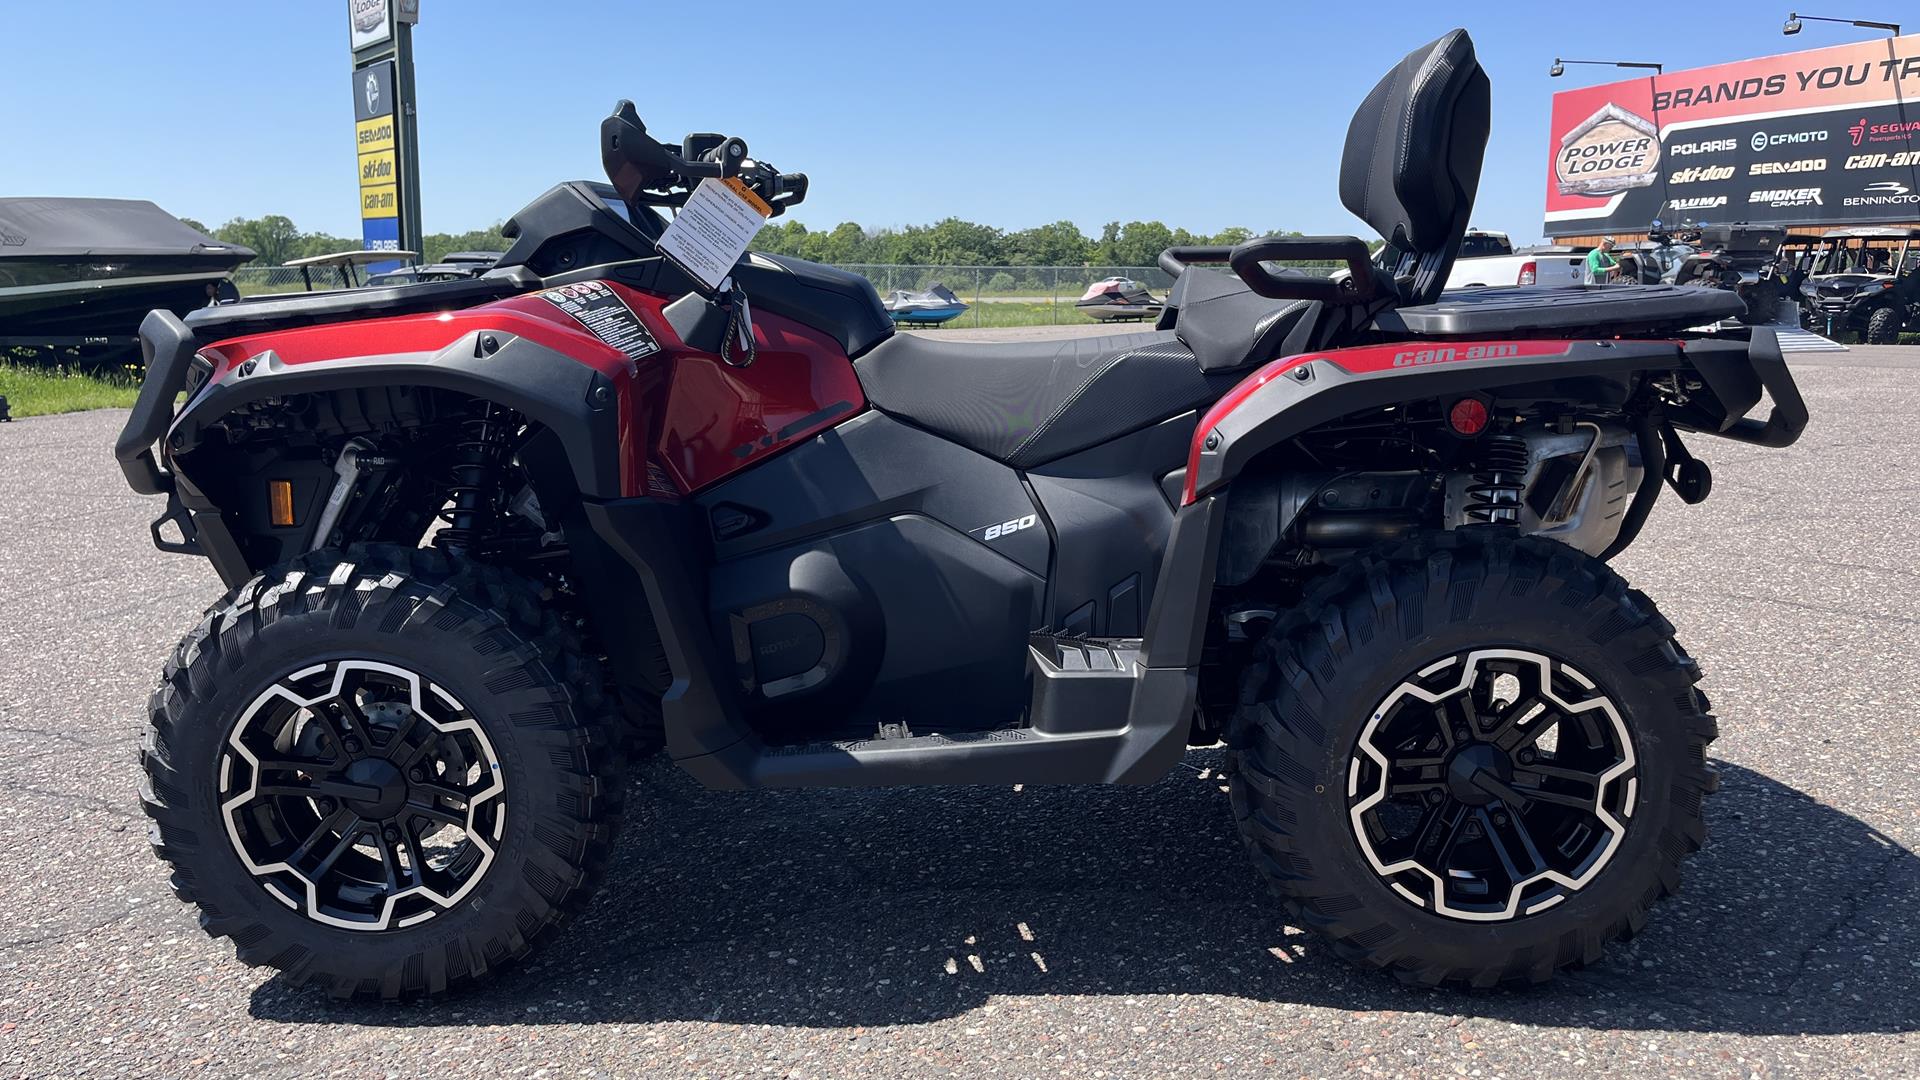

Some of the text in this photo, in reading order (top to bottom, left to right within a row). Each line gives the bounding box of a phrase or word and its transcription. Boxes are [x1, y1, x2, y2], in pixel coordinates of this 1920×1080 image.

[1652, 73, 1787, 111] BRANDS
[1796, 62, 1871, 92] YOU
[1671, 138, 1737, 156] POLARIS
[1769, 130, 1828, 145] CFMOTO
[1564, 138, 1651, 163] POWER
[1567, 154, 1646, 175] LODGE
[1669, 165, 1736, 184] ski-doo
[364, 192, 394, 209] can-am
[1669, 196, 1728, 210] ALUMA
[1748, 187, 1824, 206] SMOKER
[1771, 199, 1813, 208] CRAFT
[1392, 344, 1518, 367] can-am
[984, 514, 1036, 541] 850
